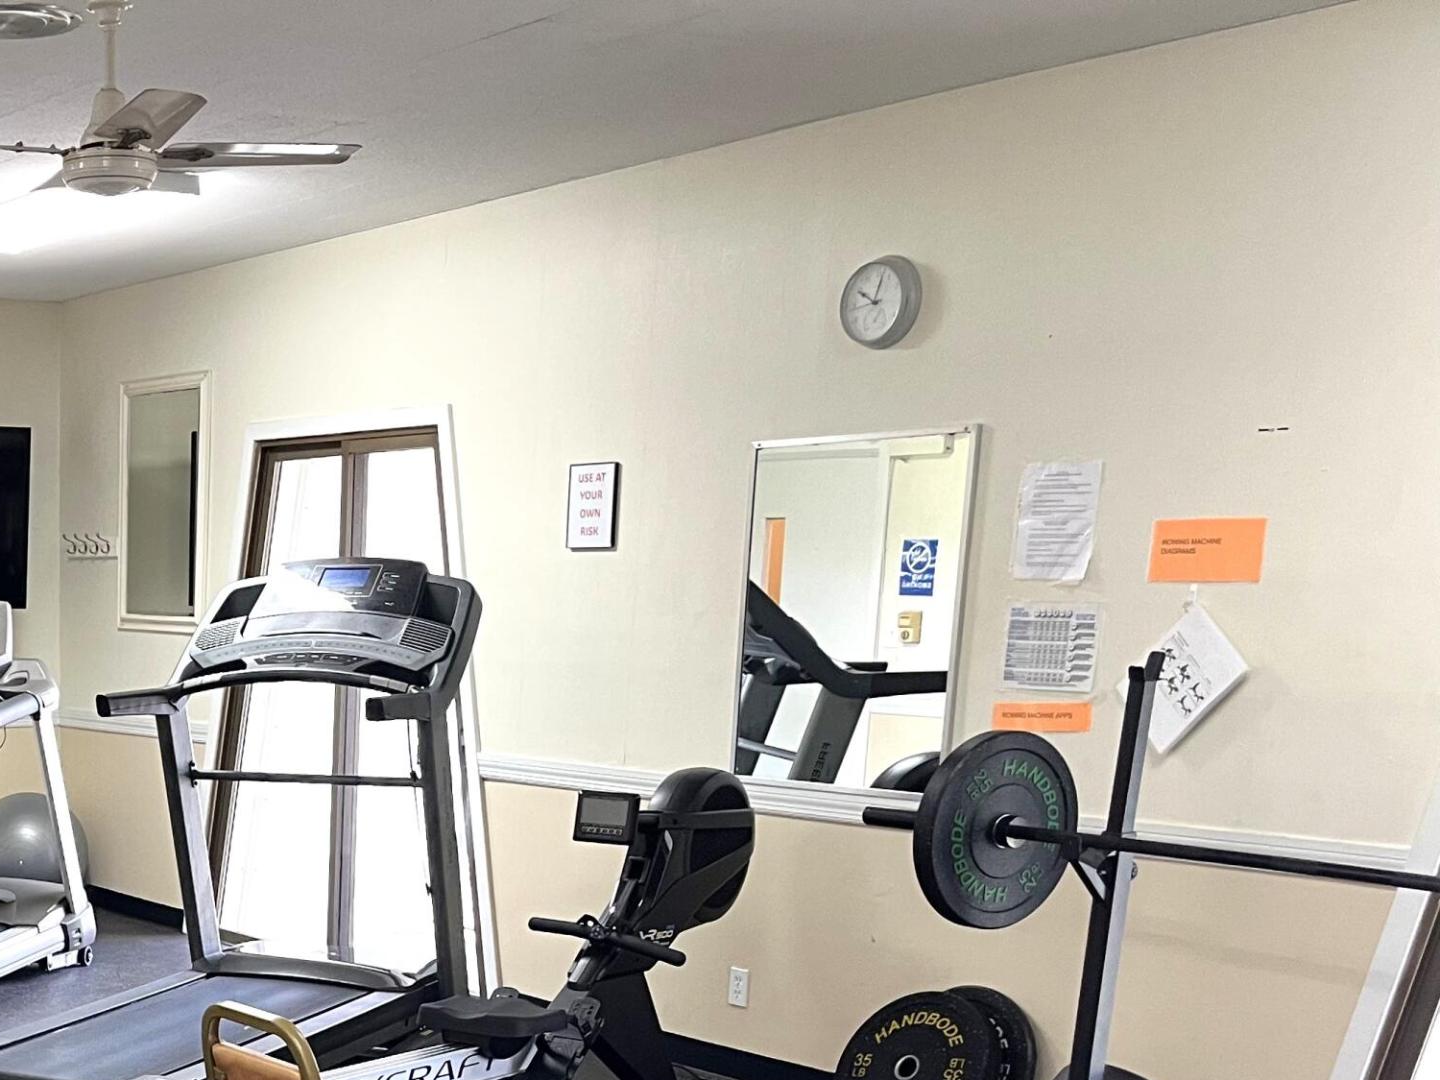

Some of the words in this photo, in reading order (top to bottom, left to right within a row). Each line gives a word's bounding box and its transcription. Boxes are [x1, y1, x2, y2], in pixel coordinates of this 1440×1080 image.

[578, 473, 594, 483] USE
[595, 472, 606, 482] AT
[579, 490, 603, 500] YOUR
[579, 508, 601, 518] OWN
[580, 526, 599, 536] RISK
[973, 768, 995, 794] 25
[951, 809, 1009, 903] HANDBODE
[874, 1011, 964, 1048] HANDBODE
[854, 1053, 873, 1067] 35
[949, 1058, 966, 1069] LB
[851, 1067, 866, 1078] LB
